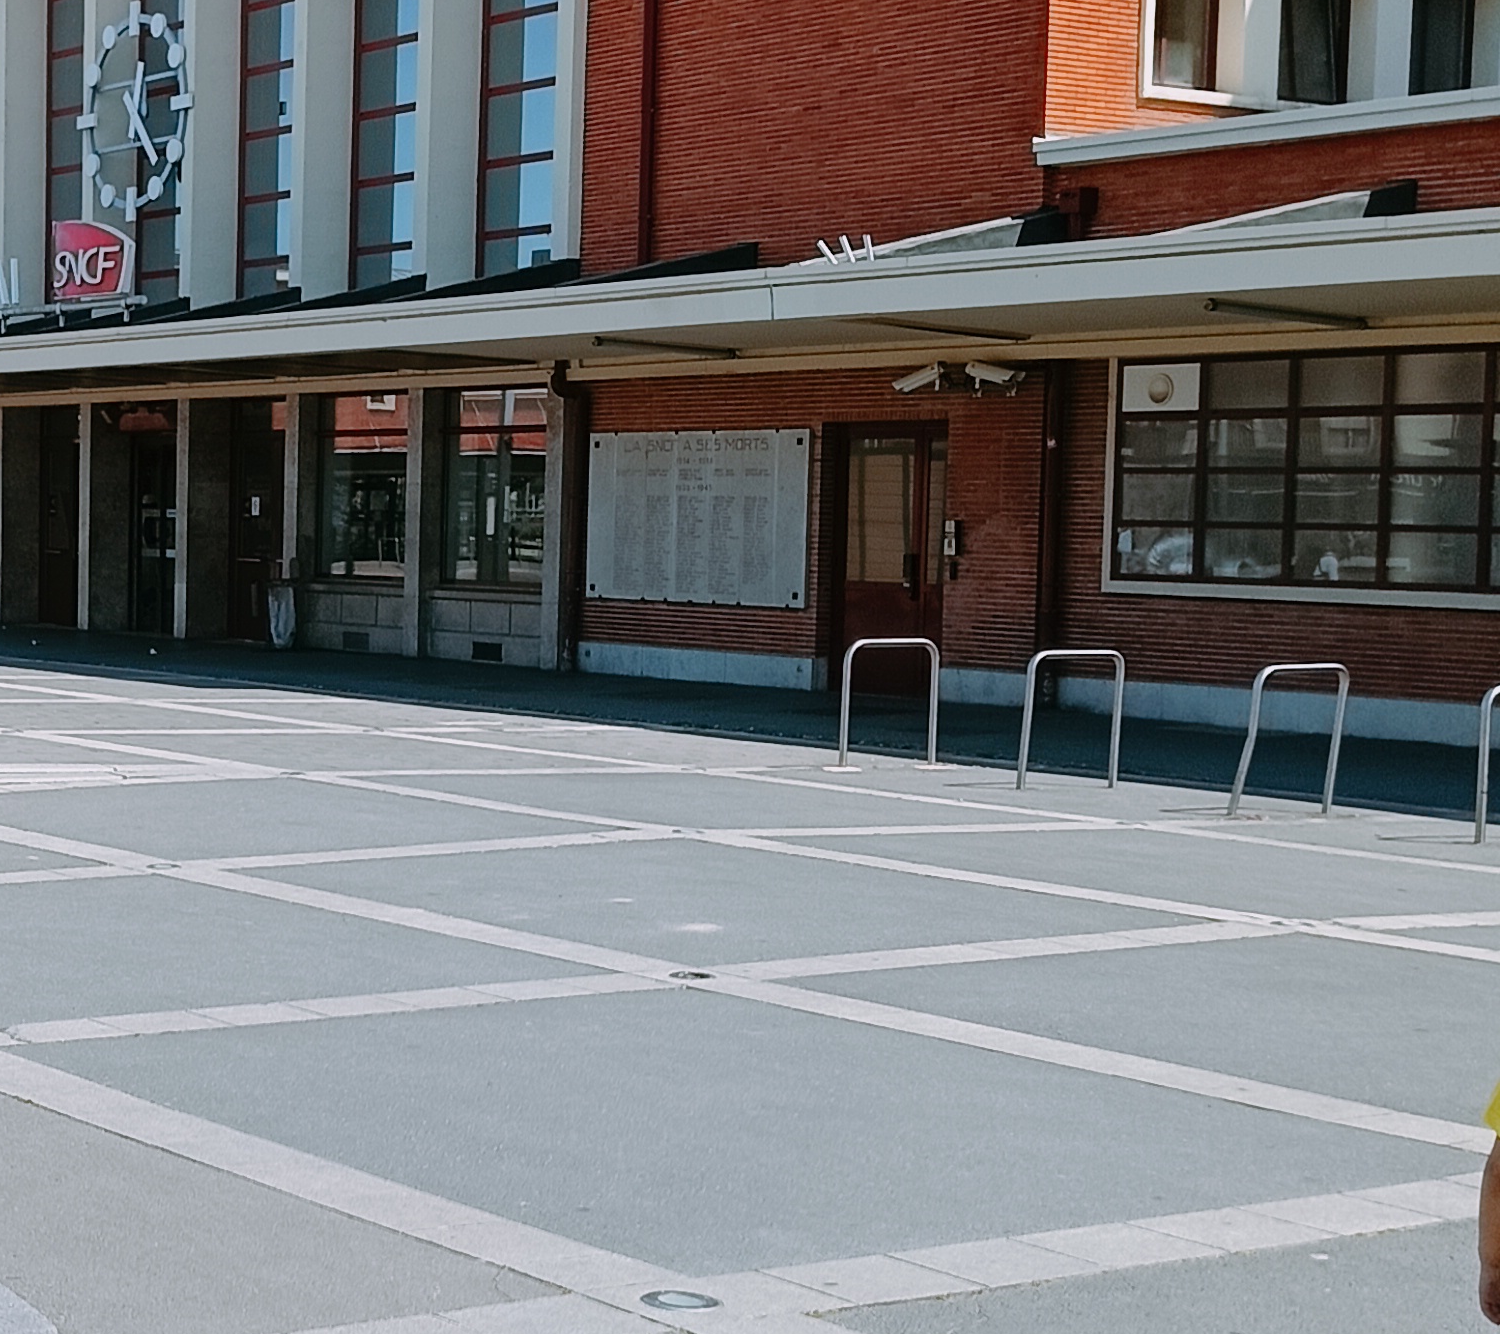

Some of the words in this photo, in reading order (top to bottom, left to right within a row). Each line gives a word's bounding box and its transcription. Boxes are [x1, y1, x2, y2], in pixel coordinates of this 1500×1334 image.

[53, 245, 121, 288] SNCF
[683, 439, 692, 452] A
[696, 439, 721, 452] SES
[725, 437, 769, 452] MORTS
